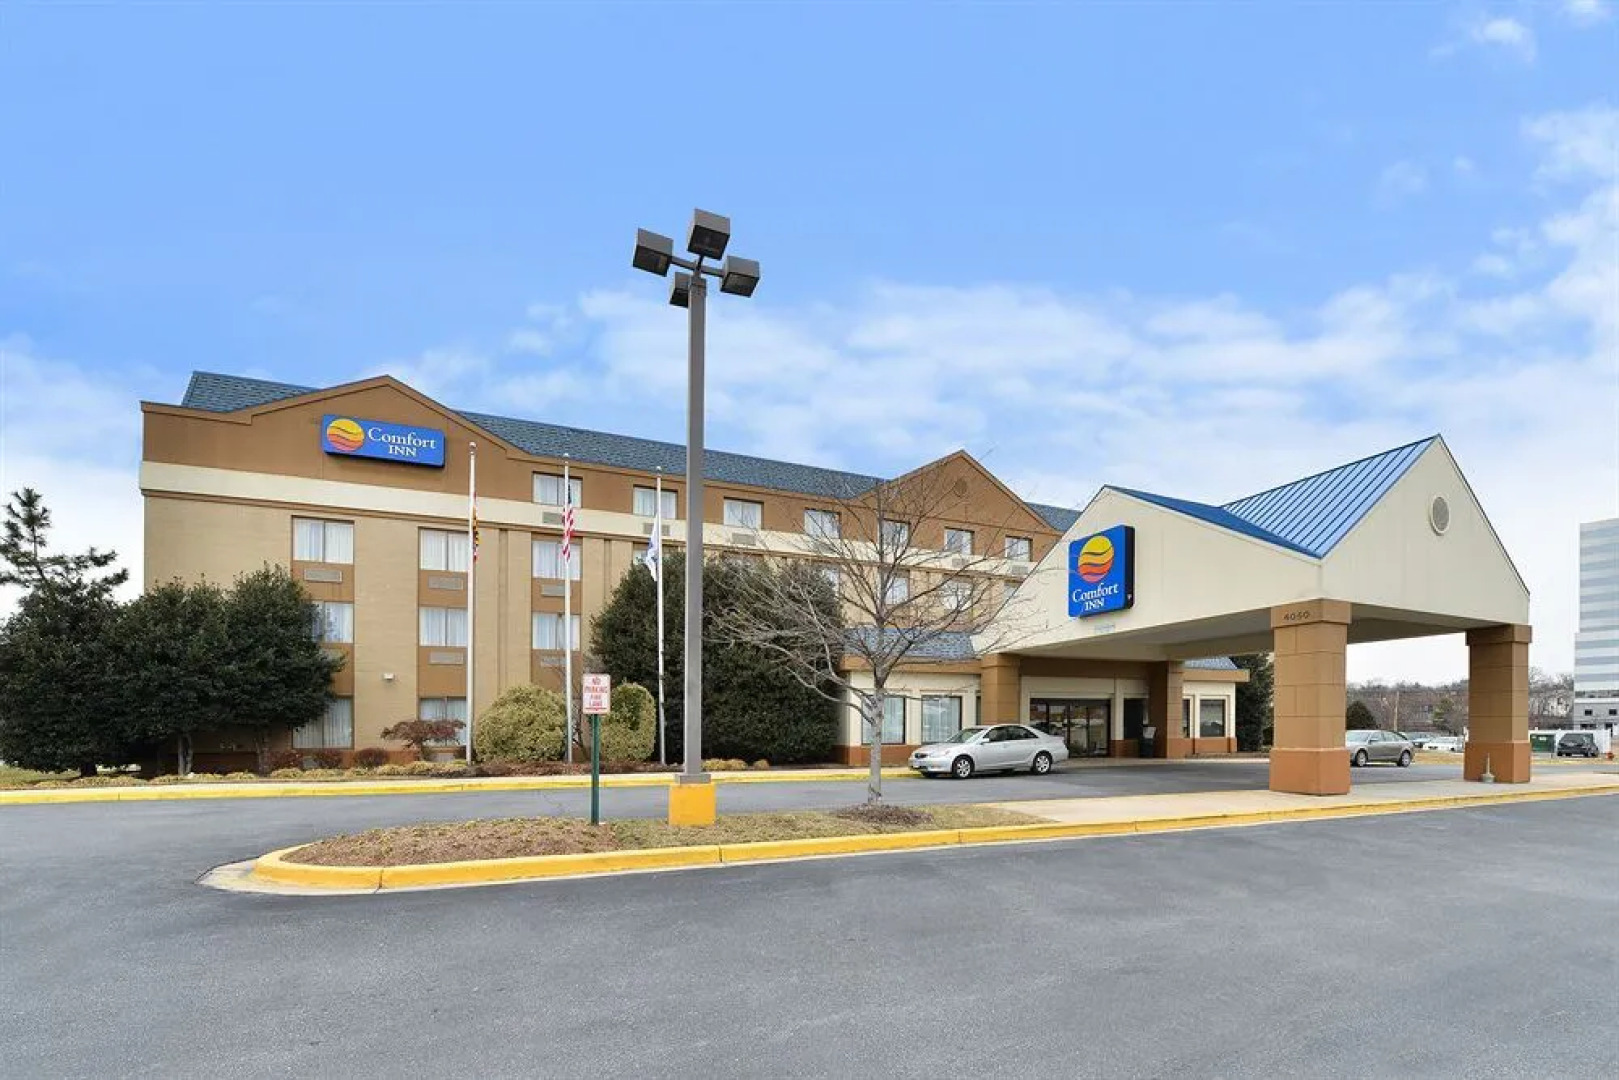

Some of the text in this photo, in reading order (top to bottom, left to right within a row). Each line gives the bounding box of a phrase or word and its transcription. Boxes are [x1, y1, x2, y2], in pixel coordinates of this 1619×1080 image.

[368, 427, 437, 449] Comfort
[388, 444, 417, 457] INN
[1072, 582, 1119, 603] Comfort
[1084, 597, 1105, 611] INN
